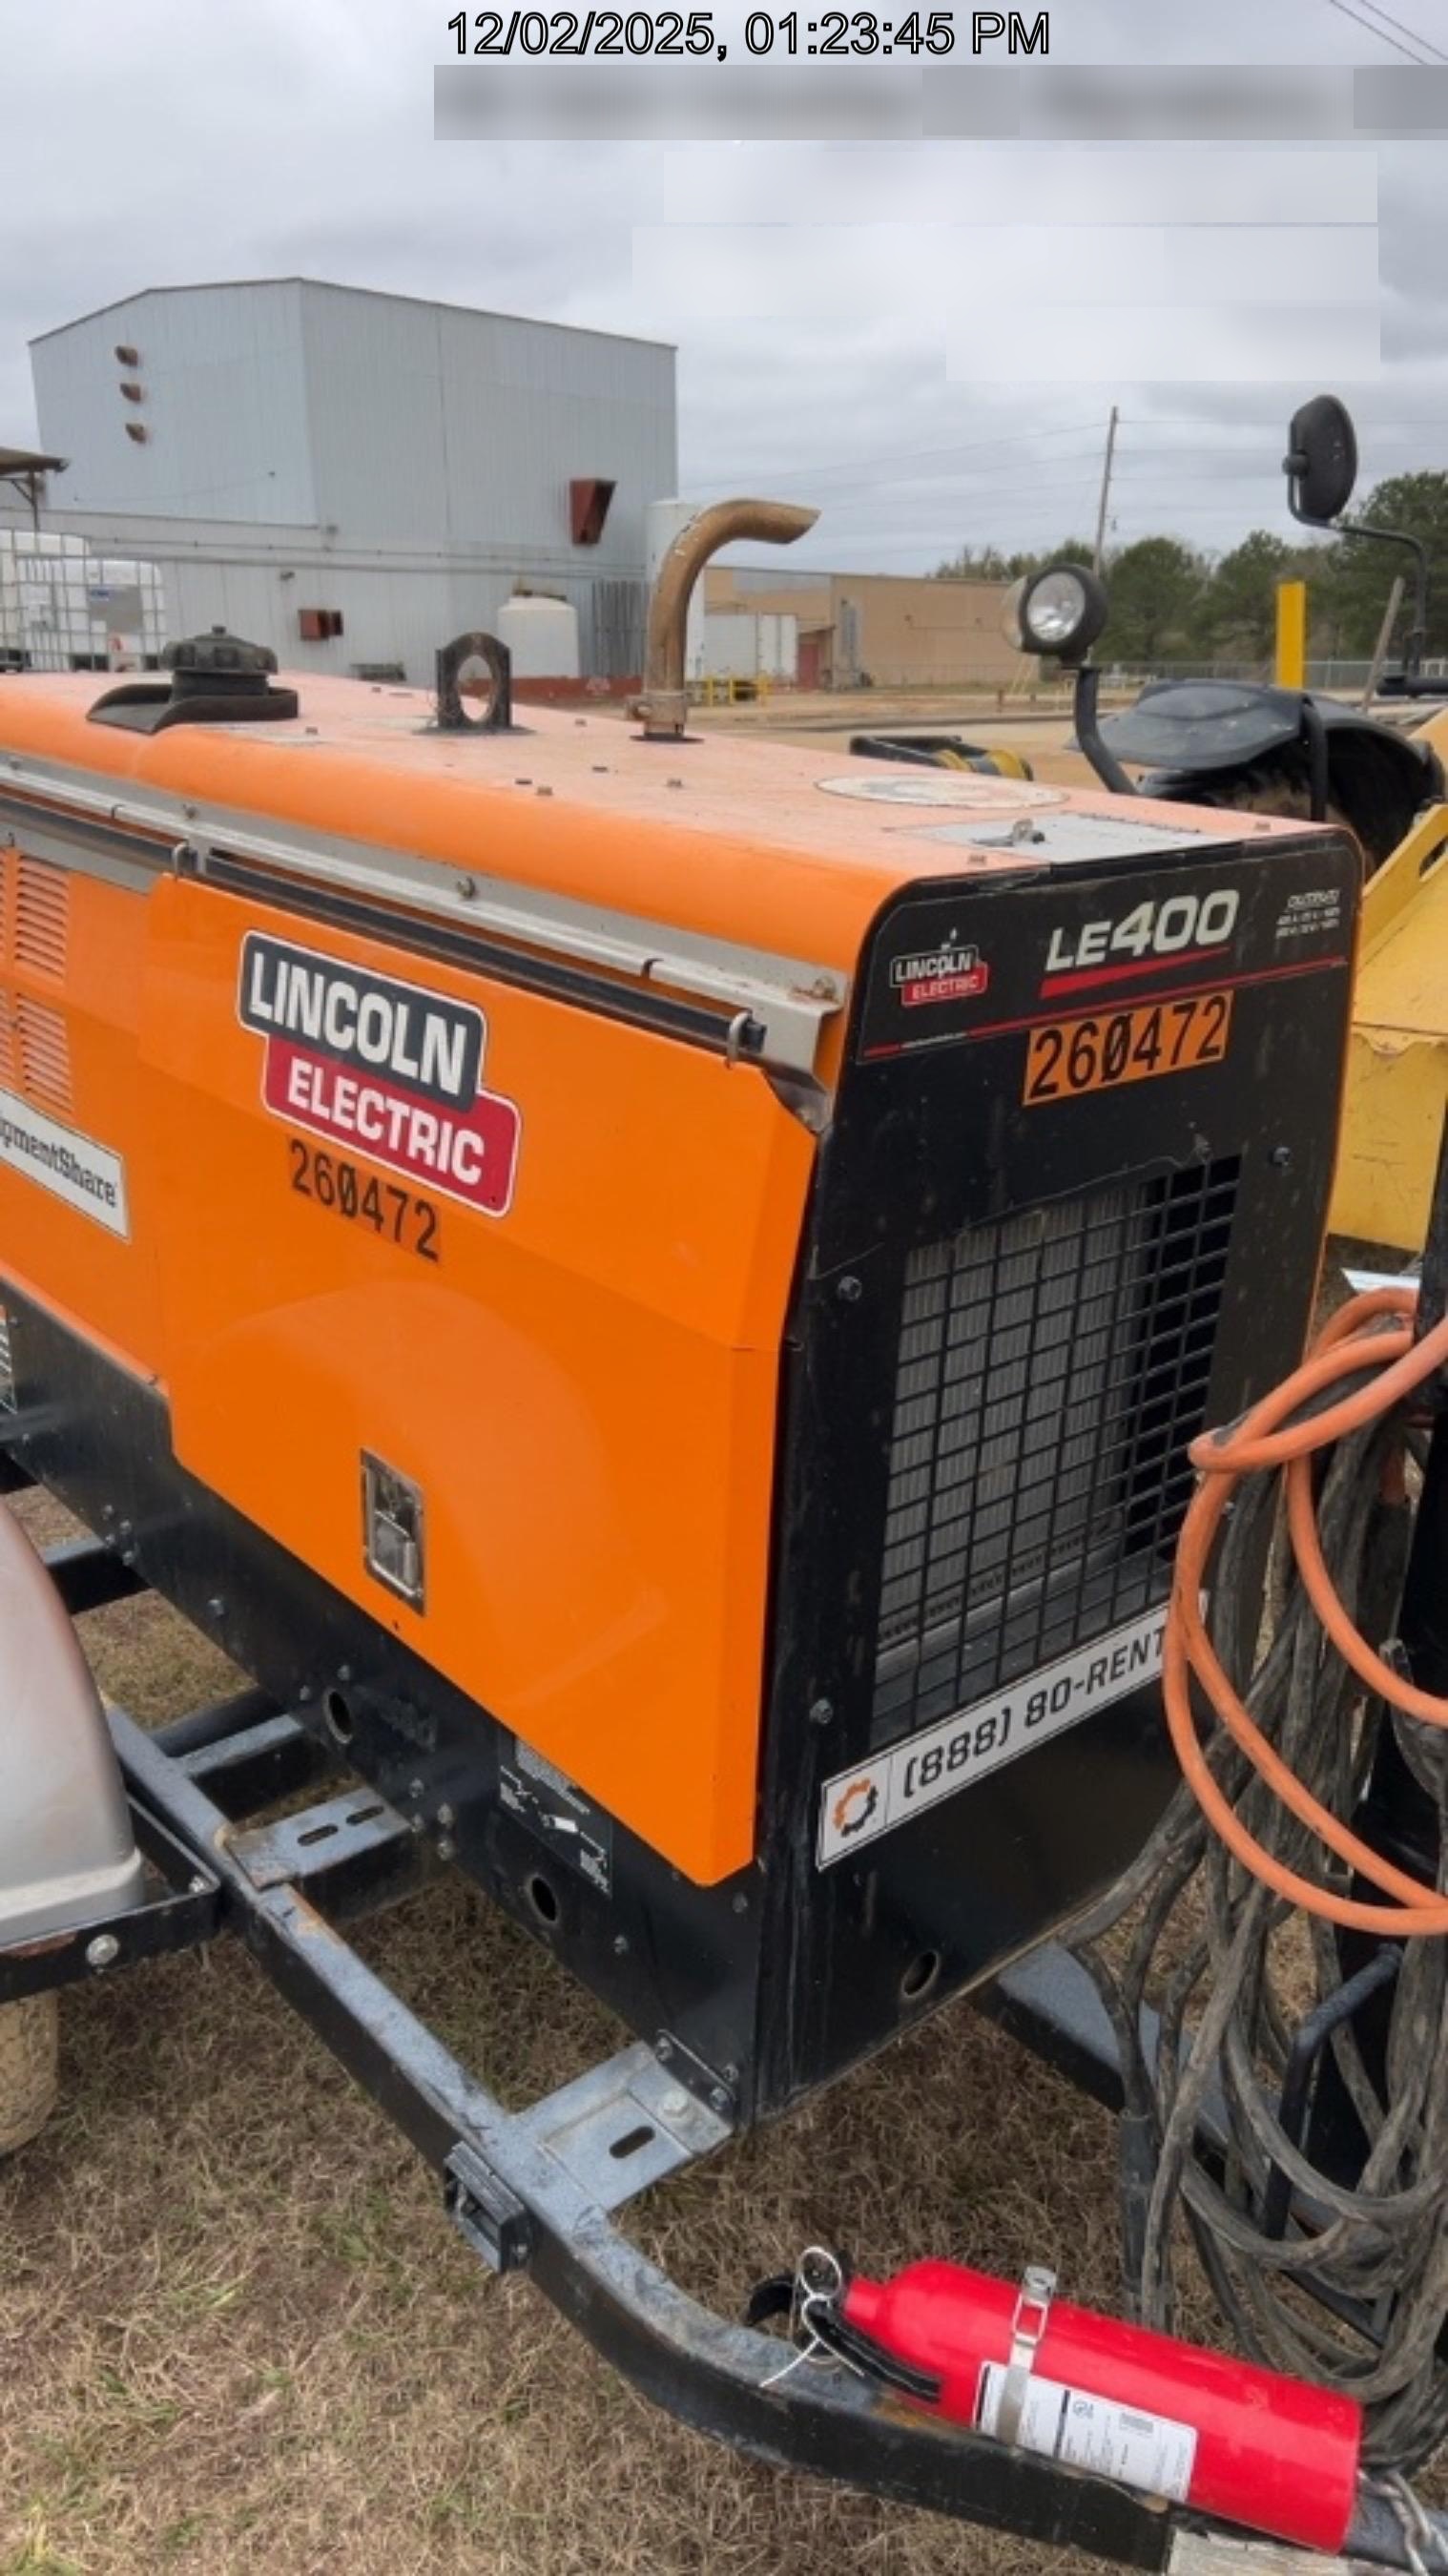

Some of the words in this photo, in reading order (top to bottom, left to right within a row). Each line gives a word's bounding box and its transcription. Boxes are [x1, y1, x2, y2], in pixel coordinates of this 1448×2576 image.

[895, 952, 972, 982] LINCOLN
[1045, 889, 1240, 972] LE400
[249, 952, 467, 1096] LINCOLN
[912, 975, 979, 1000] ELECTRIC
[1029, 995, 1228, 1100] 260472
[288, 1056, 486, 1185] ELECTRIC
[290, 1138, 439, 1262] 260472
[903, 1706, 1010, 1797] (888)
